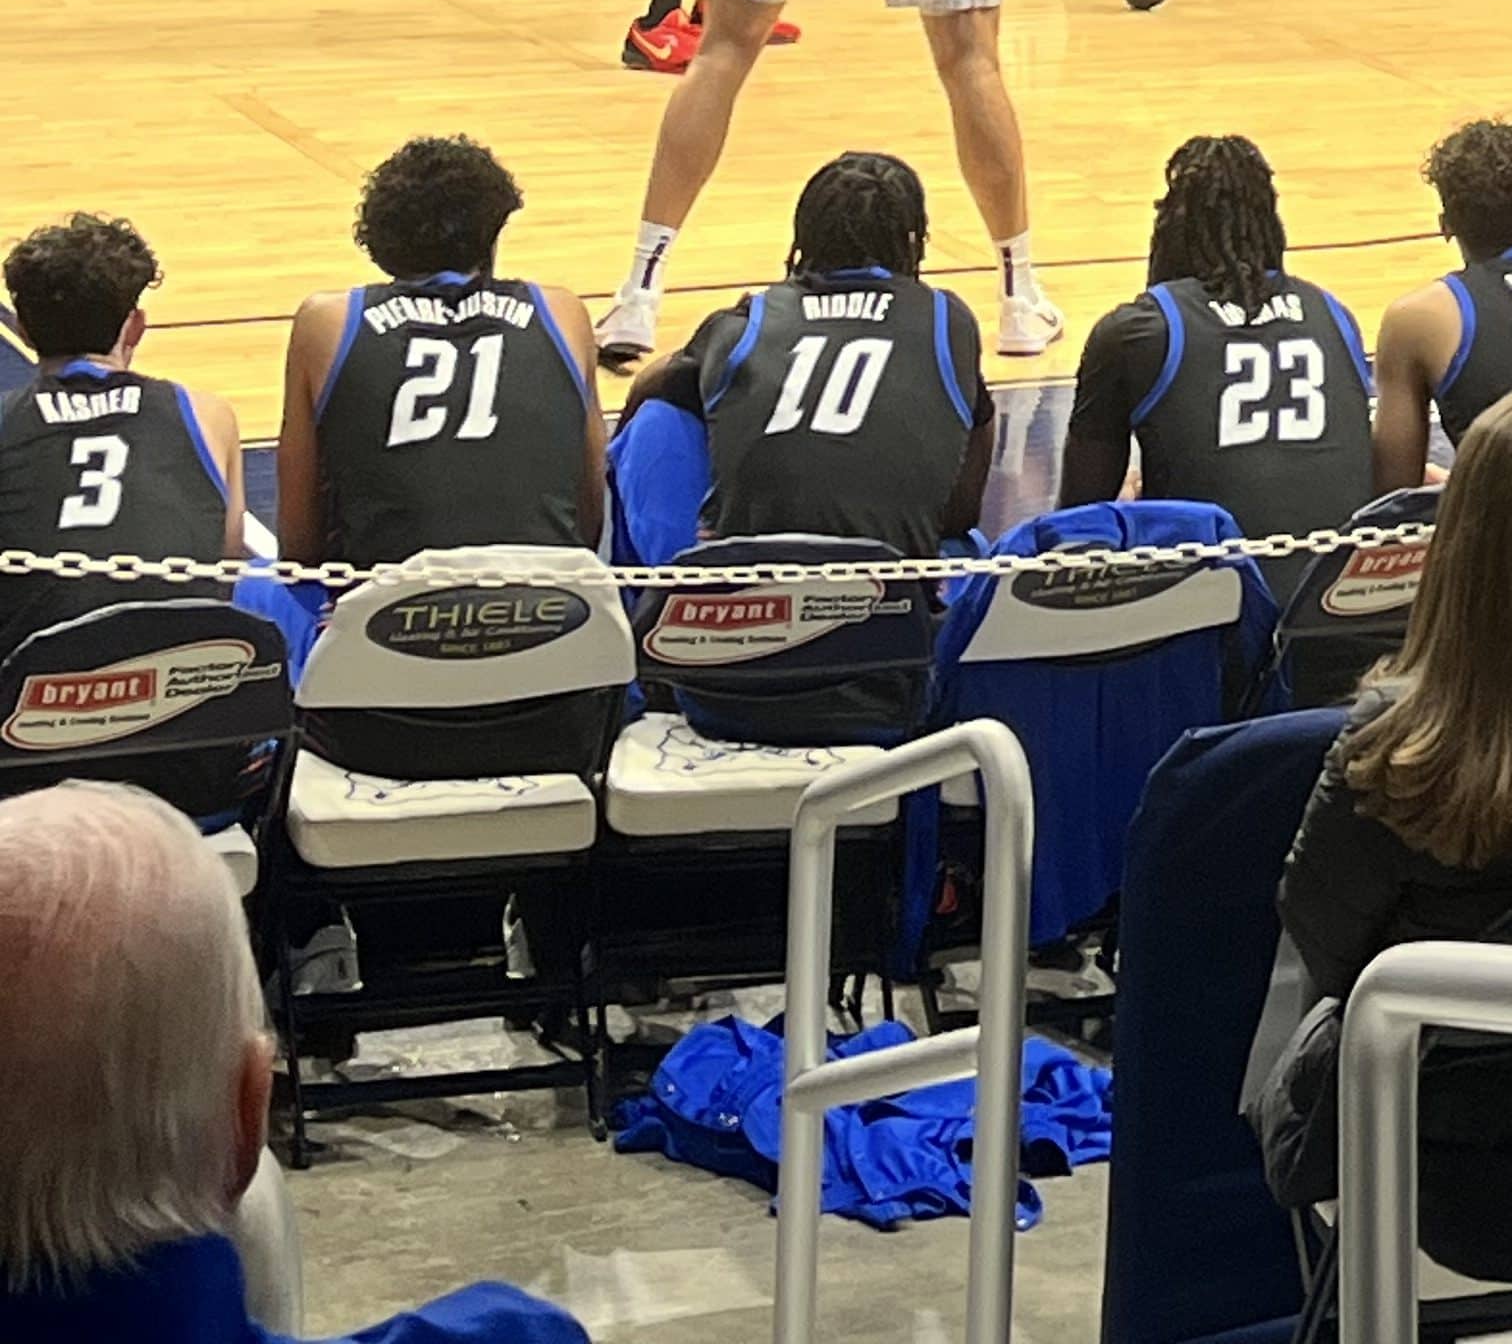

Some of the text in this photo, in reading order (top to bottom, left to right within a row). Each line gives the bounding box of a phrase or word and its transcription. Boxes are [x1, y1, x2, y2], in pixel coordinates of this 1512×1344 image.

[363, 290, 535, 335] PIERRE-JUSTIN
[802, 291, 894, 322] RIDDLE
[386, 333, 504, 448] 21
[764, 335, 893, 435] 10
[1218, 339, 1326, 448] 23
[58, 435, 130, 529] 3
[1359, 550, 1428, 573] bryan
[392, 597, 570, 631] THIELE
[681, 601, 776, 631] bryant
[41, 676, 144, 705] bryant
